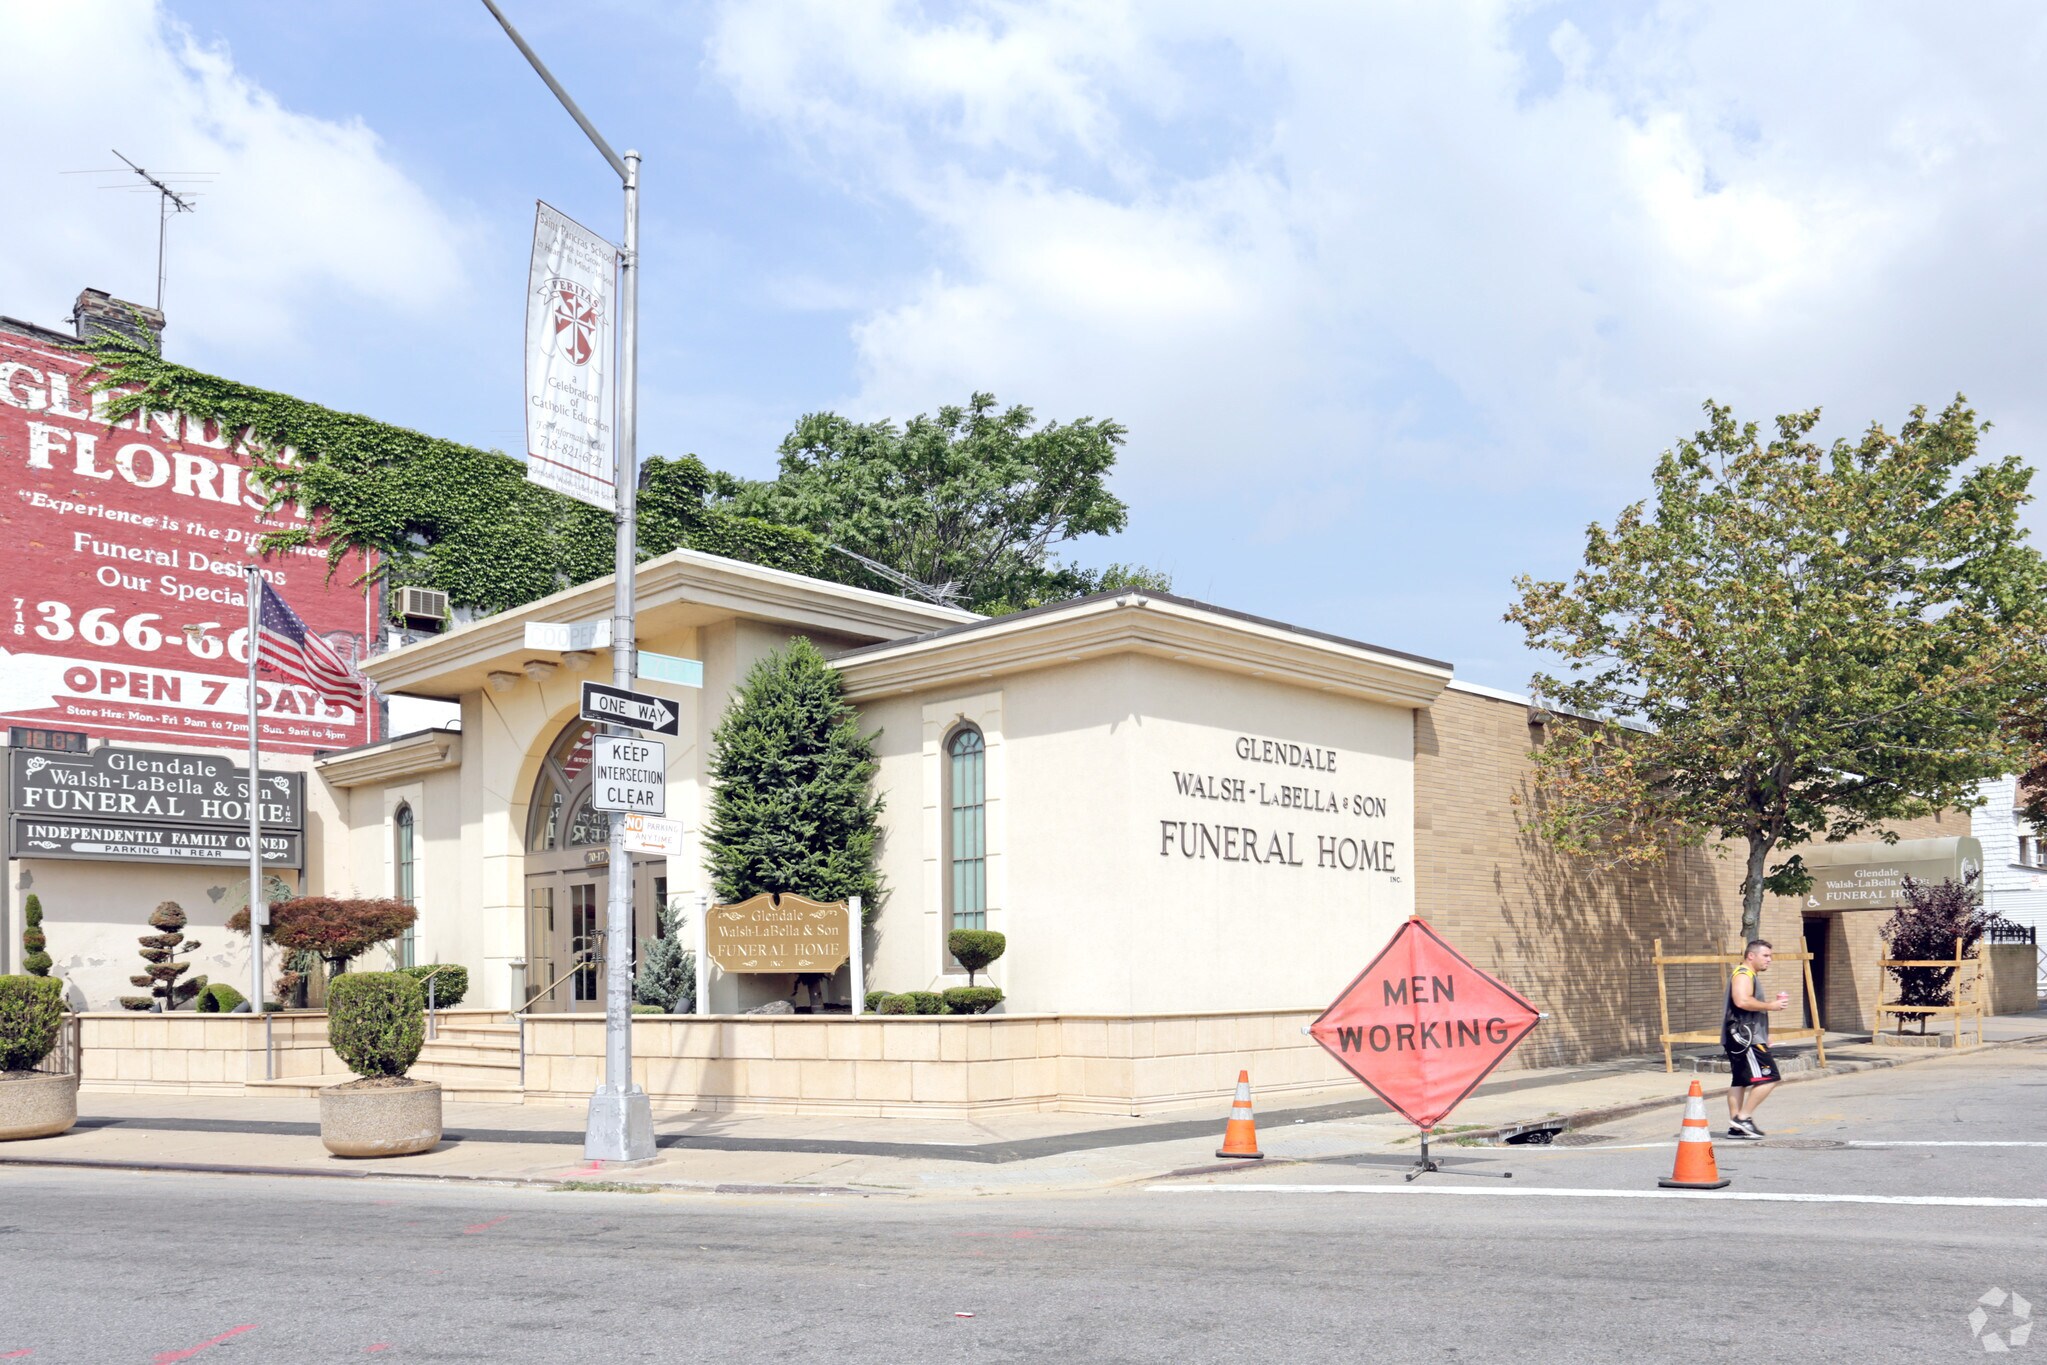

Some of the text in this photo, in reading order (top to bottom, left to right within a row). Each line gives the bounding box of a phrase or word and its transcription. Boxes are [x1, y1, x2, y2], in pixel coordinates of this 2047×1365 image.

[540, 212, 615, 265] Saint Pancras School
[574, 258, 590, 273] Mind
[552, 280, 599, 308] VERITAS
[548, 376, 599, 404] Celebration
[532, 395, 570, 417] Catholic
[570, 398, 579, 408] of
[540, 435, 603, 469] 718-821-6721
[162, 515, 180, 532] is
[187, 521, 220, 541] the
[254, 515, 285, 529] Since
[73, 531, 179, 568] Funeral
[97, 565, 151, 593] Our
[529, 625, 597, 647] COOPER
[63, 666, 345, 719] OPEN 7 DAYS
[599, 696, 626, 715] ONE
[638, 704, 666, 722] WAY
[66, 704, 98, 718] Store
[101, 707, 125, 721] Hrs:
[184, 716, 207, 729] 9am
[211, 719, 223, 730] to
[225, 720, 249, 732] 7pm
[262, 724, 284, 735] Sun.
[288, 727, 309, 737] 9am
[312, 730, 322, 738] to
[325, 730, 346, 740] 4pm
[107, 753, 217, 778] Glendale
[612, 744, 649, 763] KEEP
[1236, 736, 1337, 773] GLENDALE
[50, 769, 203, 795] Walsh-LaBella
[213, 781, 230, 797] &
[597, 765, 663, 785] INTERSECTION
[23, 787, 185, 817] FUNERAL
[607, 786, 654, 807] CLEAR
[1342, 797, 1349, 809] &
[1353, 794, 1387, 818] SON
[26, 824, 163, 845] INDEPENDENTLY
[171, 833, 229, 849] FAMILY
[626, 816, 679, 833] NO PARKING
[635, 833, 673, 844] ANYTIME
[1160, 819, 1396, 873] FUNERAL HOME
[104, 844, 223, 859] PARKING IN REAR
[1389, 875, 1402, 884] INC.
[1826, 878, 1896, 889] Walsh-LaBella
[1854, 868, 1899, 879] Glendale
[1826, 890, 1886, 900] FUNERAL
[751, 909, 804, 922] Glendale
[718, 923, 839, 938] Walsh-LaBella & Son
[718, 943, 840, 957] FUNERAL HOME
[1383, 974, 1455, 1007] MEN
[1337, 1017, 1509, 1053] WORKING
